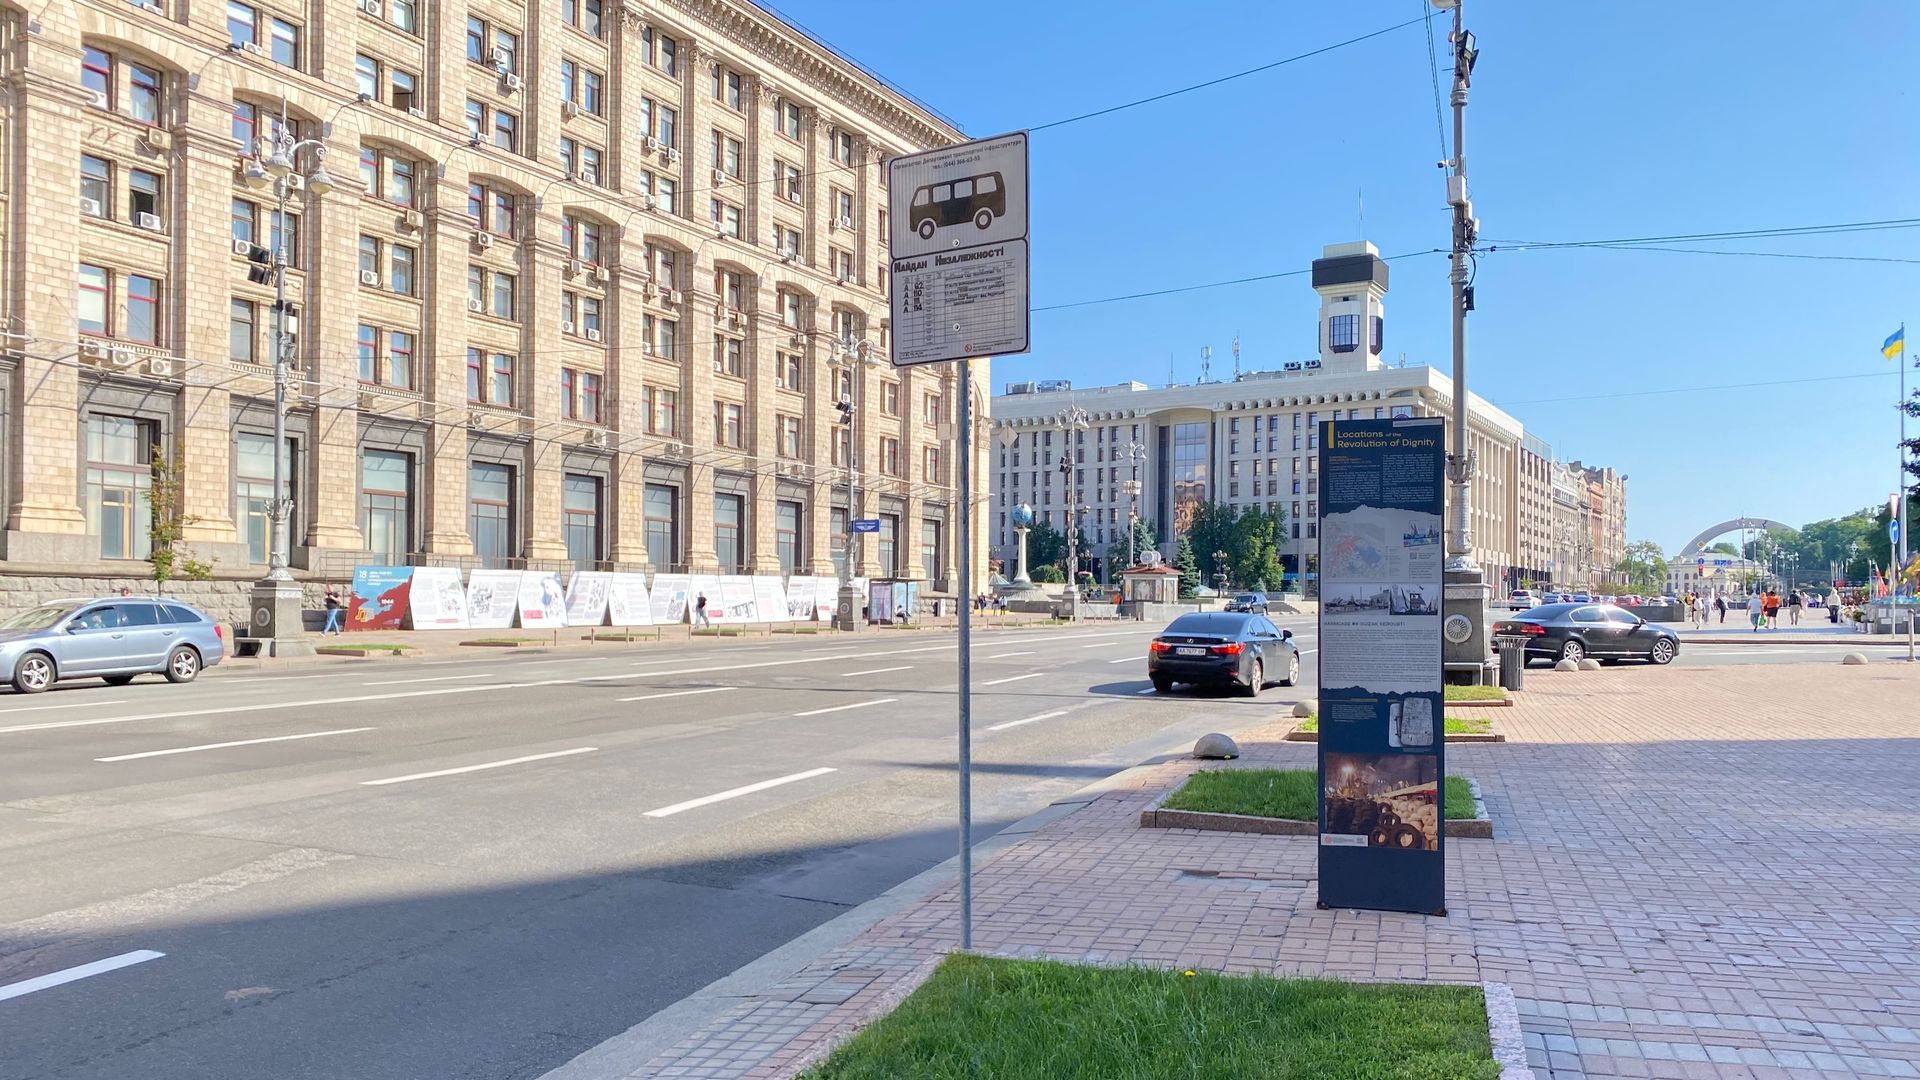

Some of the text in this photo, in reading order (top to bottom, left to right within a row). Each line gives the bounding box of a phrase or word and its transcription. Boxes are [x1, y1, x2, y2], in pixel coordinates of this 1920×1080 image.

[1337, 430, 1383, 438] Locations
[1337, 438, 1435, 448] Revolution of Dignity
